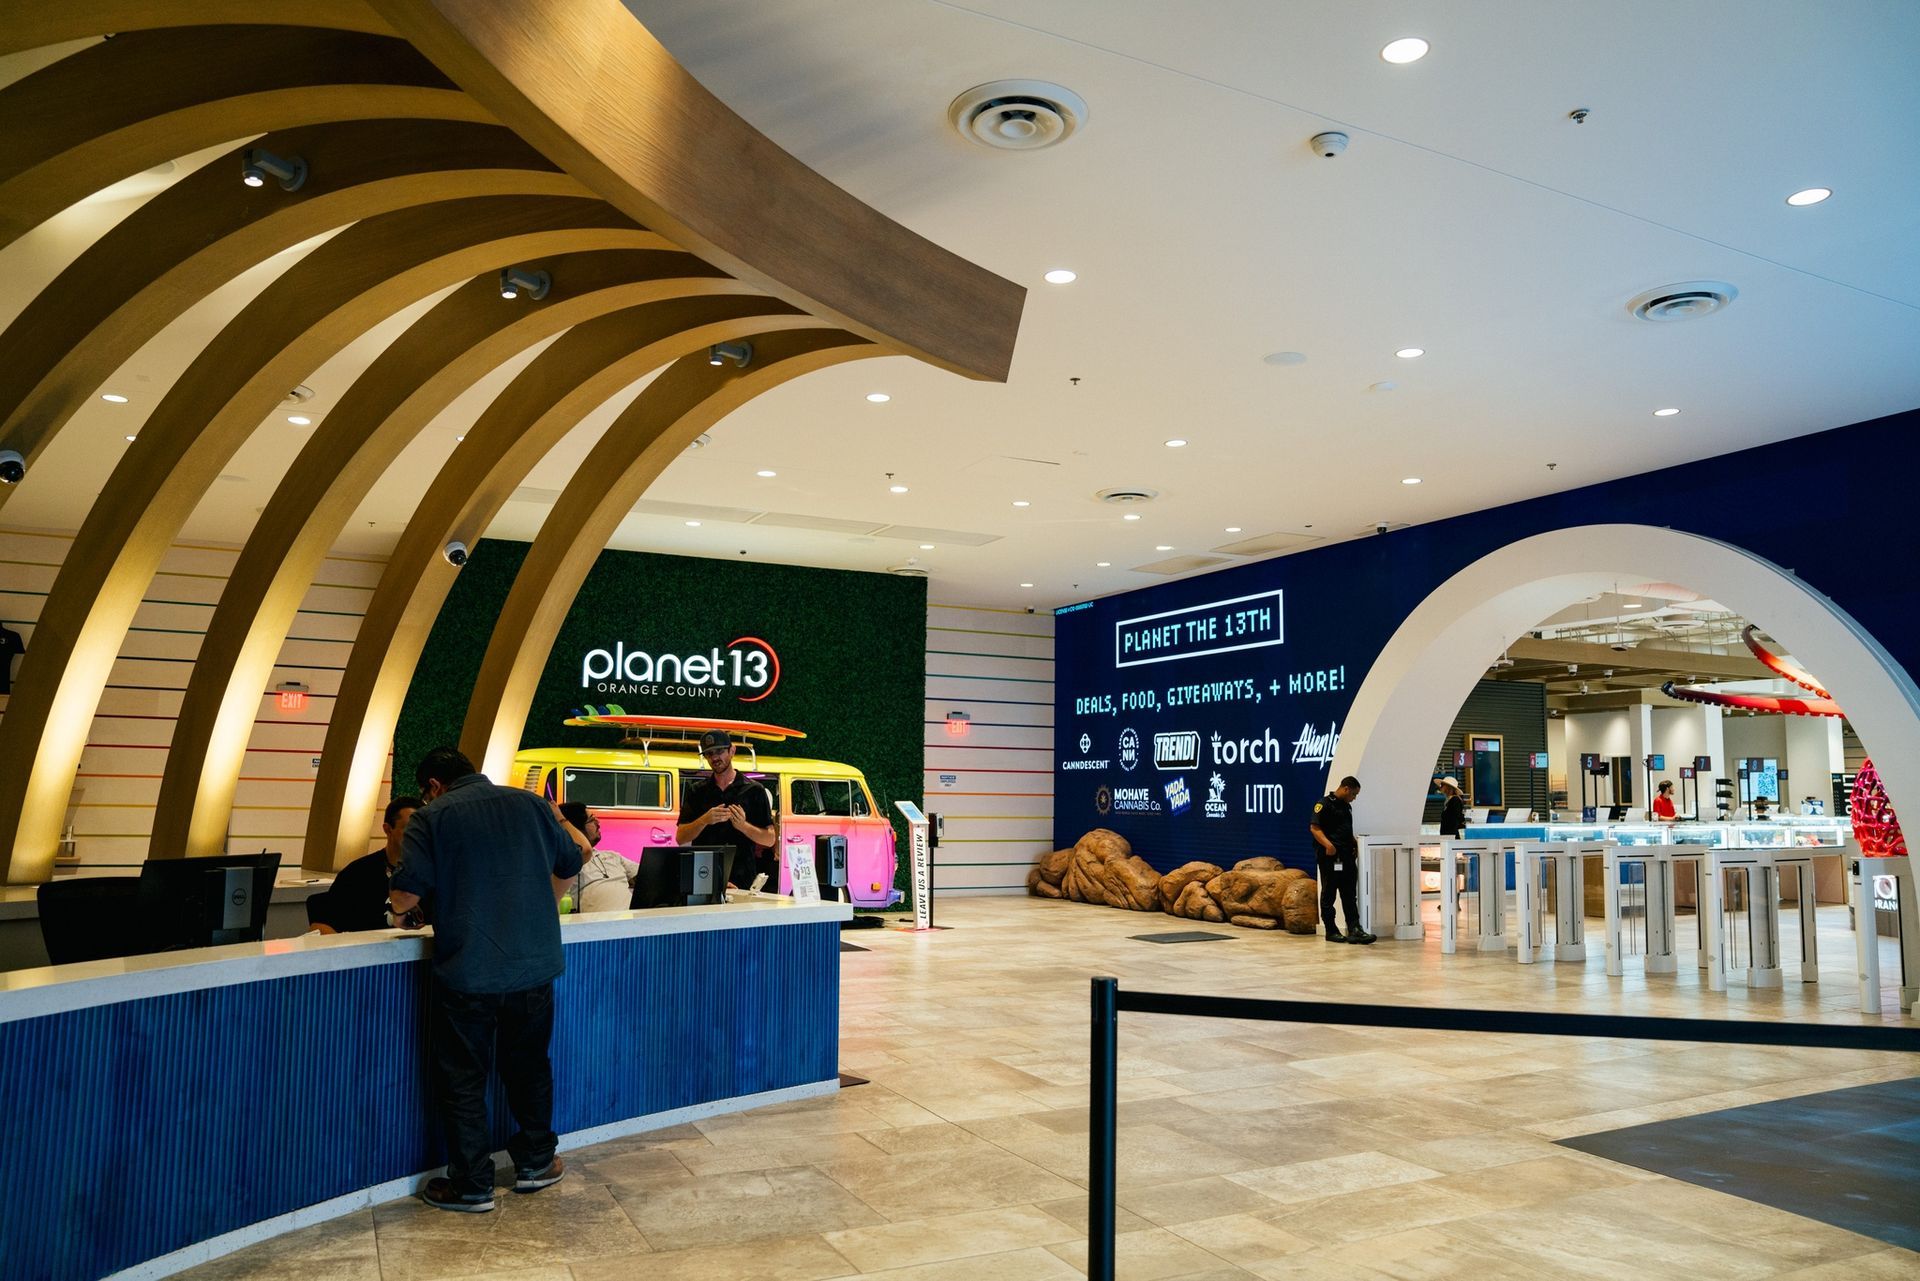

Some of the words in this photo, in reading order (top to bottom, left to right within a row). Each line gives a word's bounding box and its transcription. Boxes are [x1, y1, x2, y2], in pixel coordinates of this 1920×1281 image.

[1125, 624, 1181, 653] PLANET
[1186, 617, 1217, 642] THE
[1225, 607, 1271, 637] 13TH
[597, 682, 658, 695] ORANGE
[665, 685, 722, 698] COUNTY
[1076, 695, 1117, 716] DEALS,
[1122, 690, 1161, 712] FOOD,
[1167, 679, 1262, 706] GIVEAWAYS,
[1289, 665, 1345, 695] MORE!
[281, 693, 303, 708] EXIT
[1156, 735, 1196, 762] TRENDI
[1211, 727, 1280, 765] torch
[1062, 759, 1110, 770] CANNDESCENT
[1458, 752, 1466, 766] 3
[1587, 756, 1593, 768] 5
[1114, 788, 1149, 800] MOHAVE
[1164, 777, 1184, 799] YADA
[1114, 800, 1149, 811] CANNABIS
[1150, 800, 1162, 811] Co.
[1170, 788, 1190, 810] YADA
[1204, 802, 1228, 812] OCEAN
[1245, 784, 1284, 813] LITTO
[916, 833, 925, 868] REVIEW
[918, 878, 926, 891] US
[919, 893, 927, 919] LEAVE
